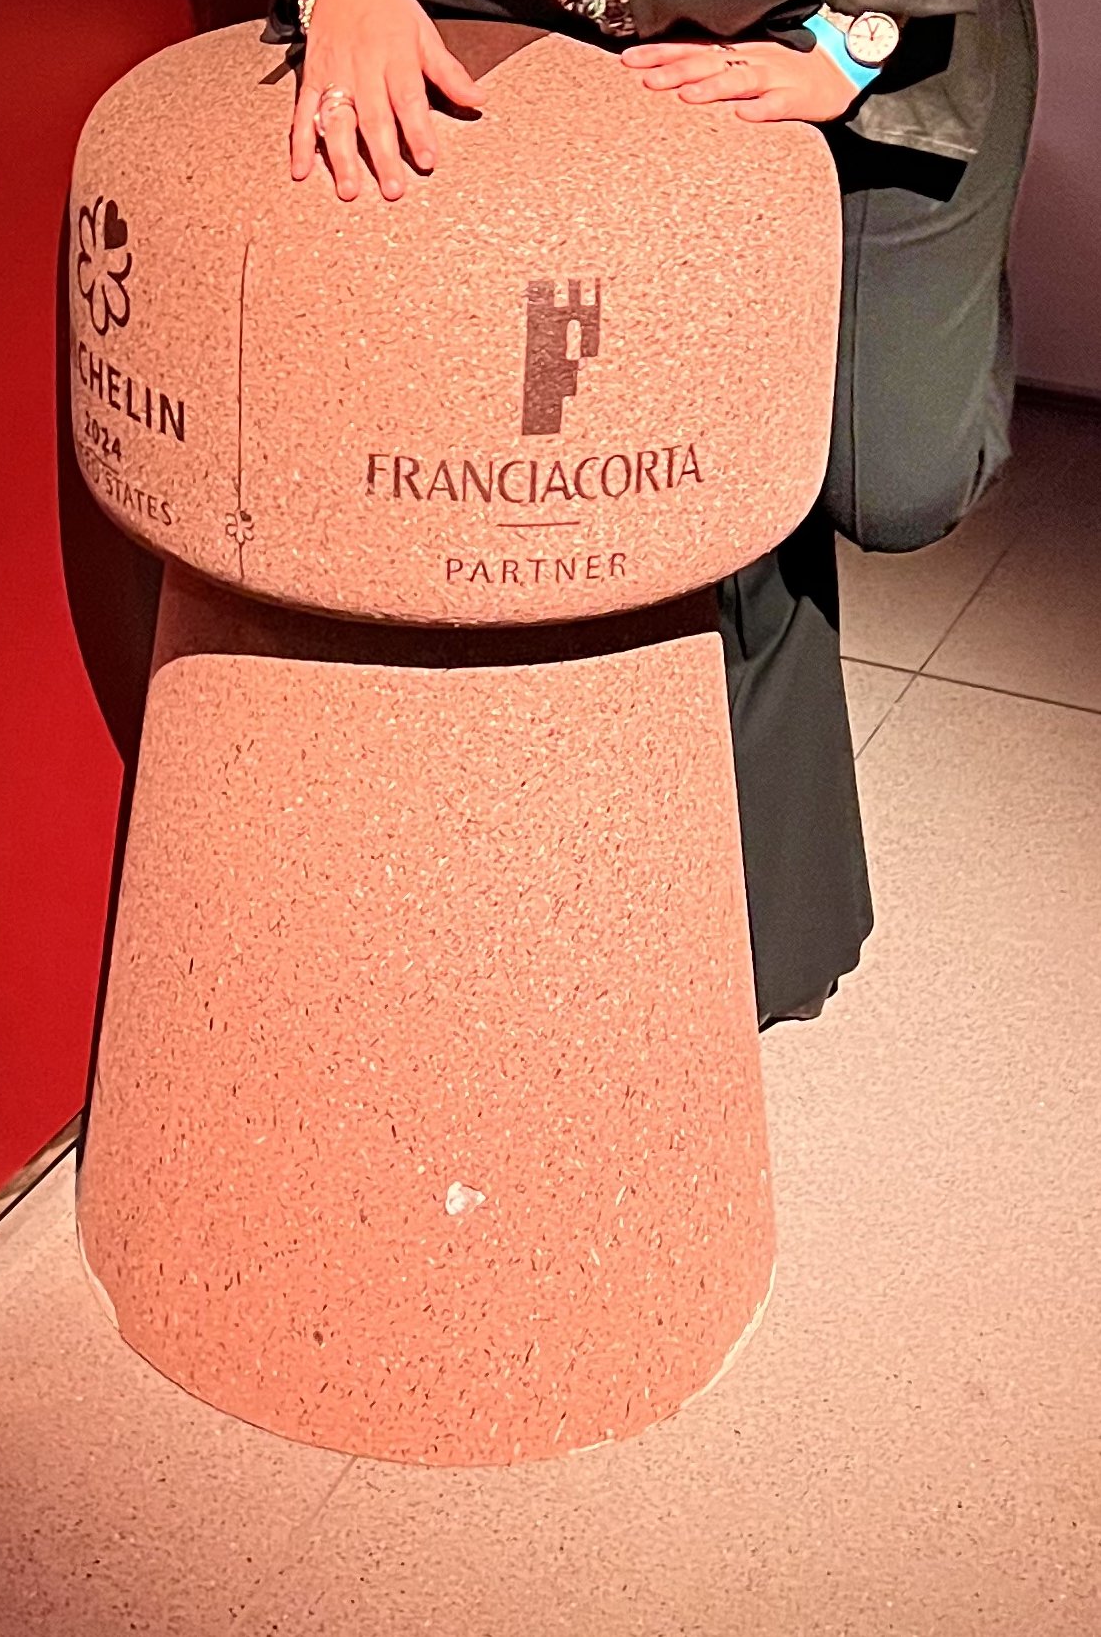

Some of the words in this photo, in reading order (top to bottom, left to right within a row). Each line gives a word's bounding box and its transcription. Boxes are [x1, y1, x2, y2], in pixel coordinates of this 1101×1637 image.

[78, 341, 185, 442] CHELIN
[85, 411, 122, 463] 2024
[105, 471, 173, 527] STATES
[365, 442, 704, 504] FRANCIACORTA
[446, 552, 627, 584] PARTNER
